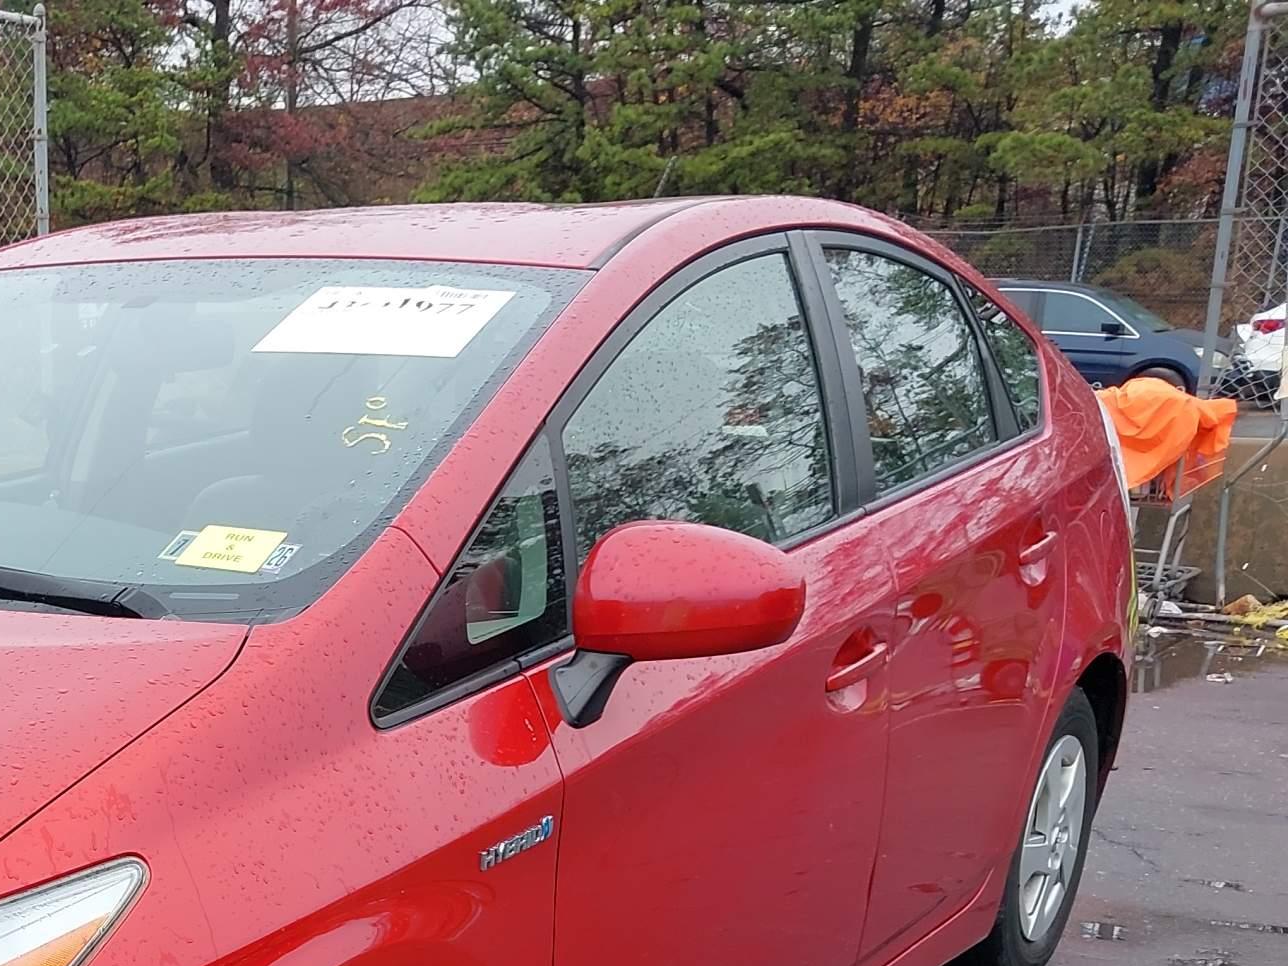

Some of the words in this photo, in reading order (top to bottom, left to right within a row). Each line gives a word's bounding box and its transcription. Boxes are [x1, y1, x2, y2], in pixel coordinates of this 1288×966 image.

[224, 532, 255, 543] RUN
[224, 543, 236, 551] &
[201, 551, 244, 563] DRIVE
[266, 546, 294, 567] 26
